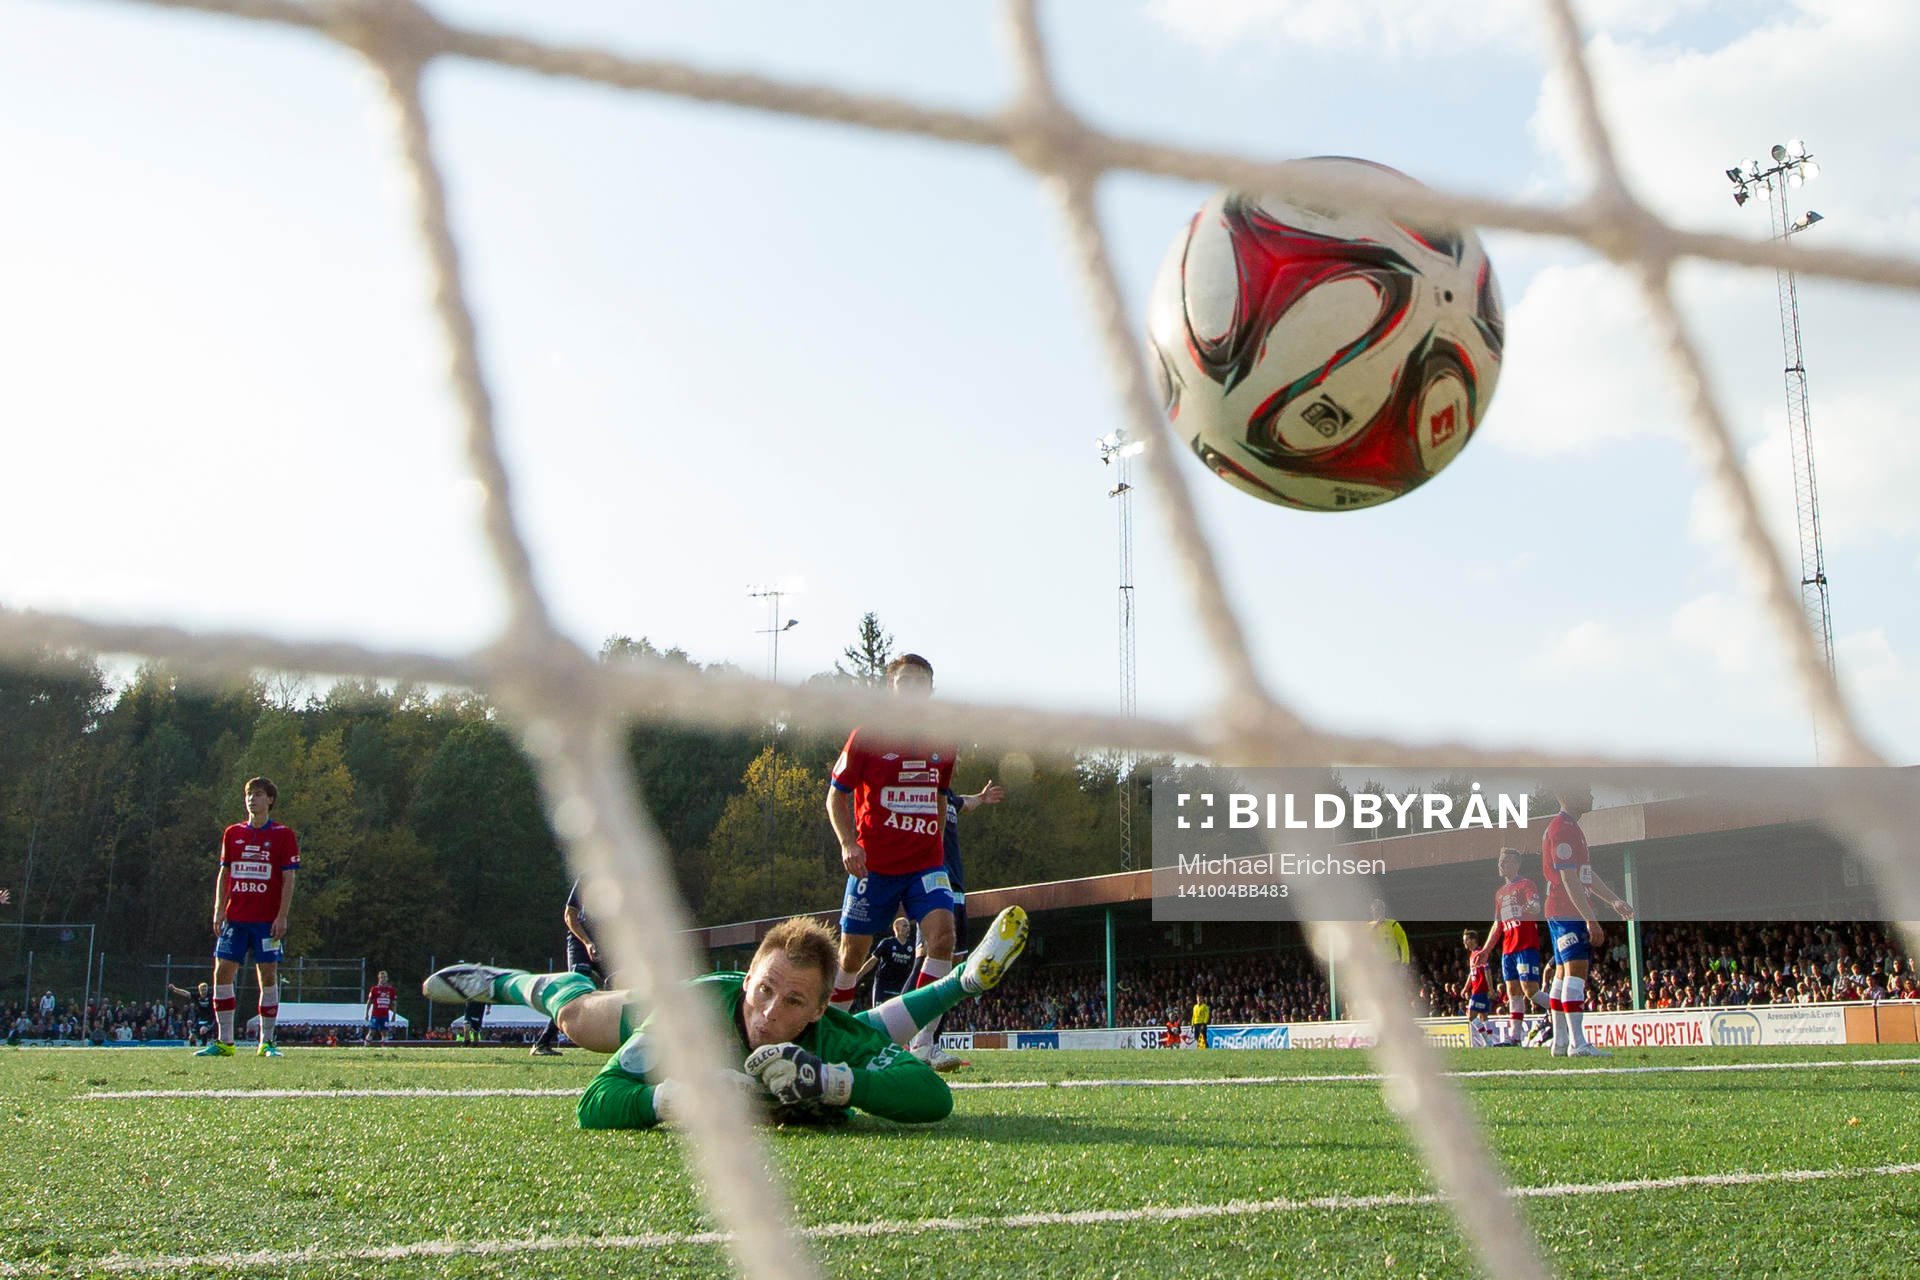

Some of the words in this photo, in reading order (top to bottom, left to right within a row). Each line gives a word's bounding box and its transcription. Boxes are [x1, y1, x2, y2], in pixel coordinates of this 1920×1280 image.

[857, 878, 868, 895] 6
[1584, 1024, 1628, 1047] TEAM
[1631, 1020, 1704, 1046] SPORTIA
[1718, 1018, 1755, 1046] fmr
